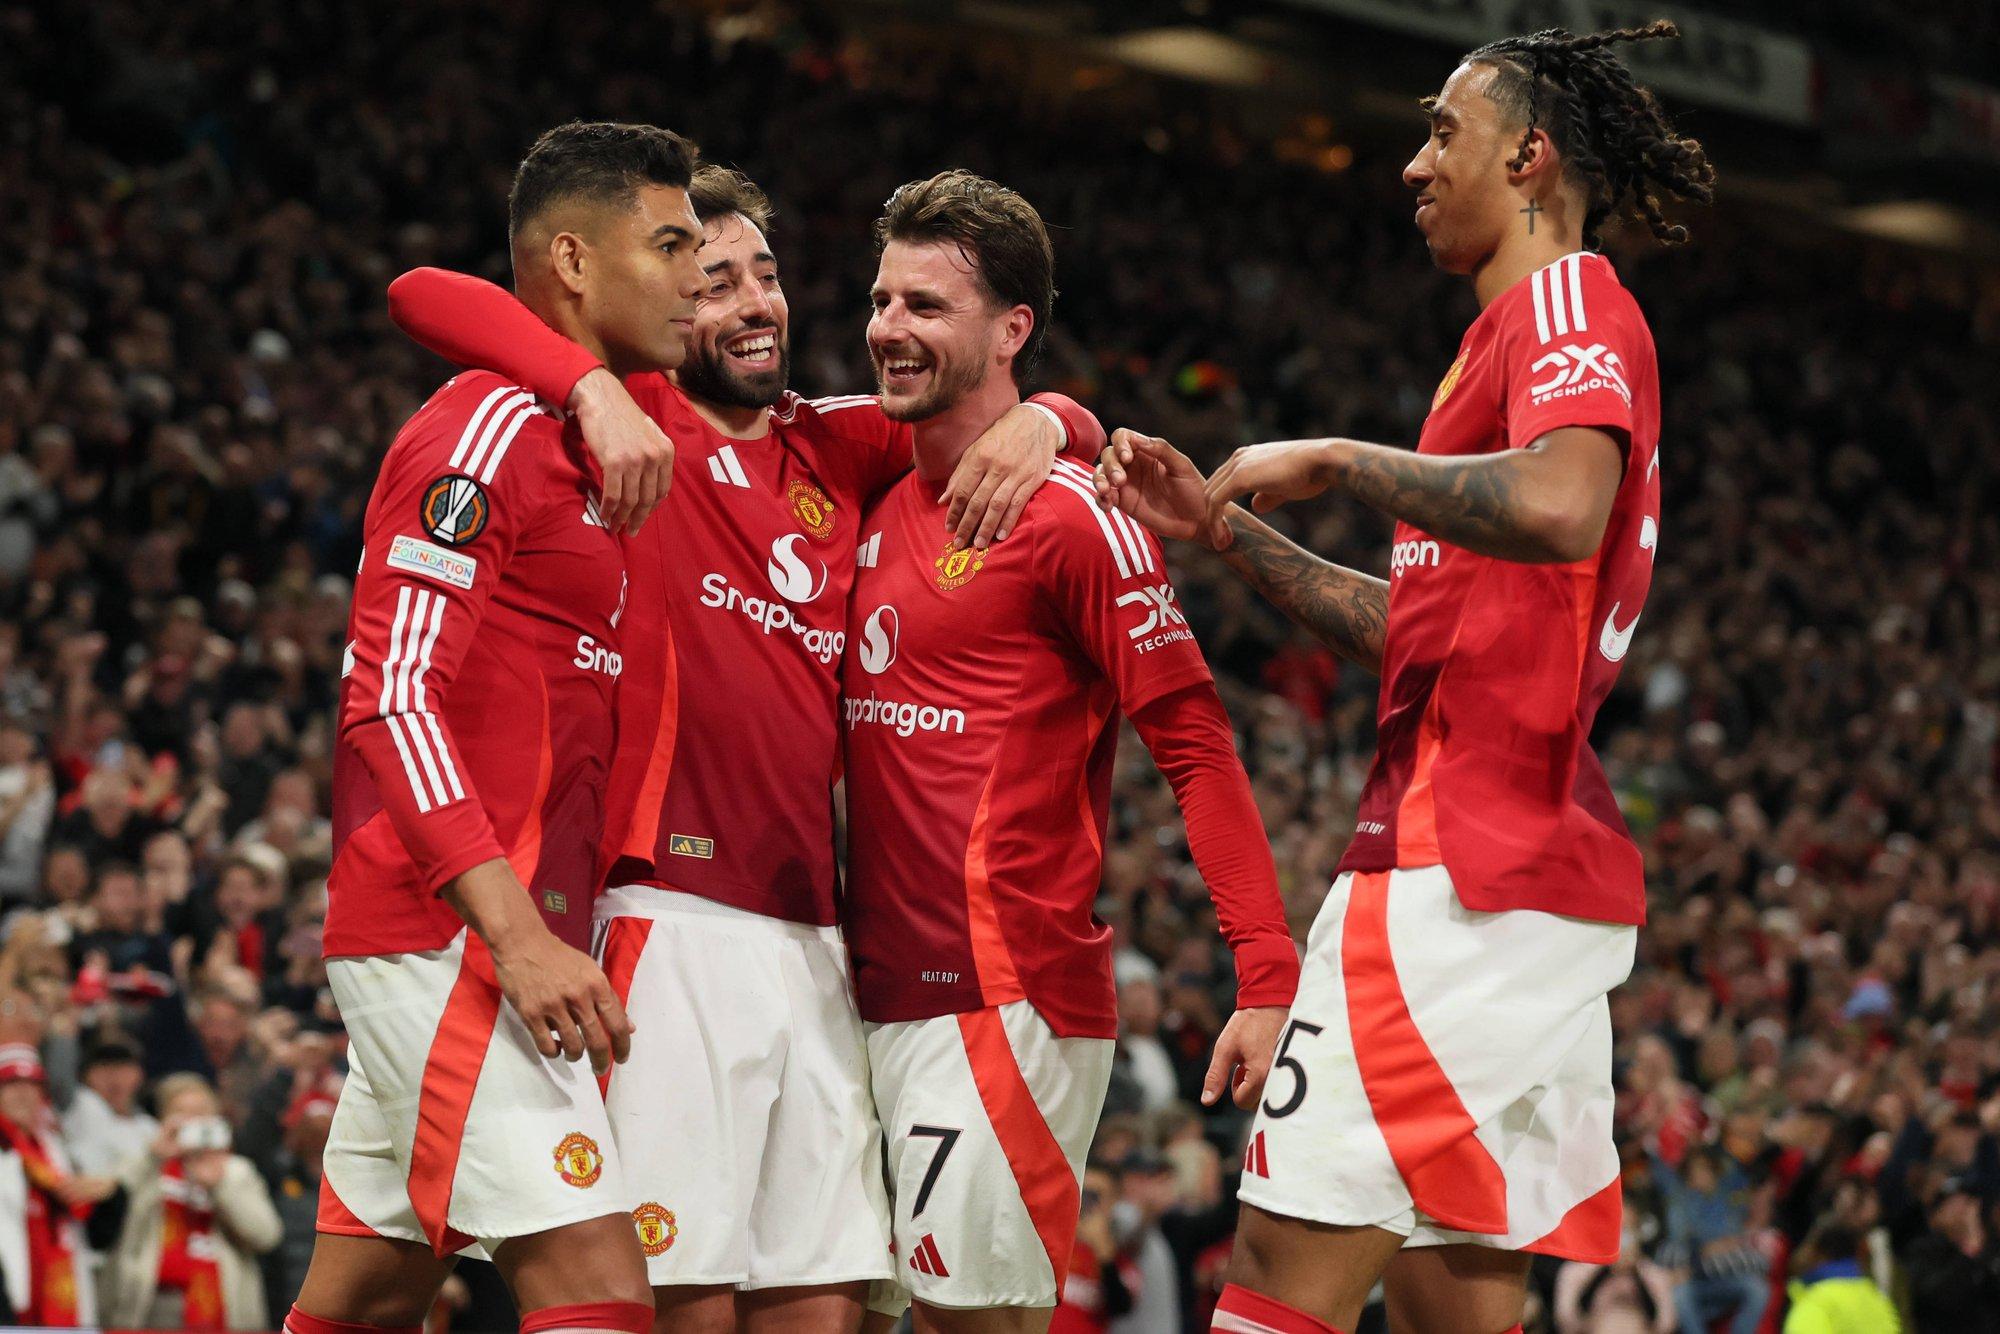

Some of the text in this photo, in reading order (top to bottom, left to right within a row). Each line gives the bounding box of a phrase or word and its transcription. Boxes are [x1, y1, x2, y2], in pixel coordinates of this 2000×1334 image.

[393, 545, 473, 578] FOUNDATION
[1134, 629, 1196, 655] TECHNOLO
[1262, 1018, 1325, 1119] 5
[556, 1135, 596, 1159] MANCHESTER
[570, 1173, 598, 1185] UNITED
[907, 1123, 965, 1222] 7
[632, 1205, 673, 1224] ANCHESTER
[642, 1241, 668, 1253] NITED
